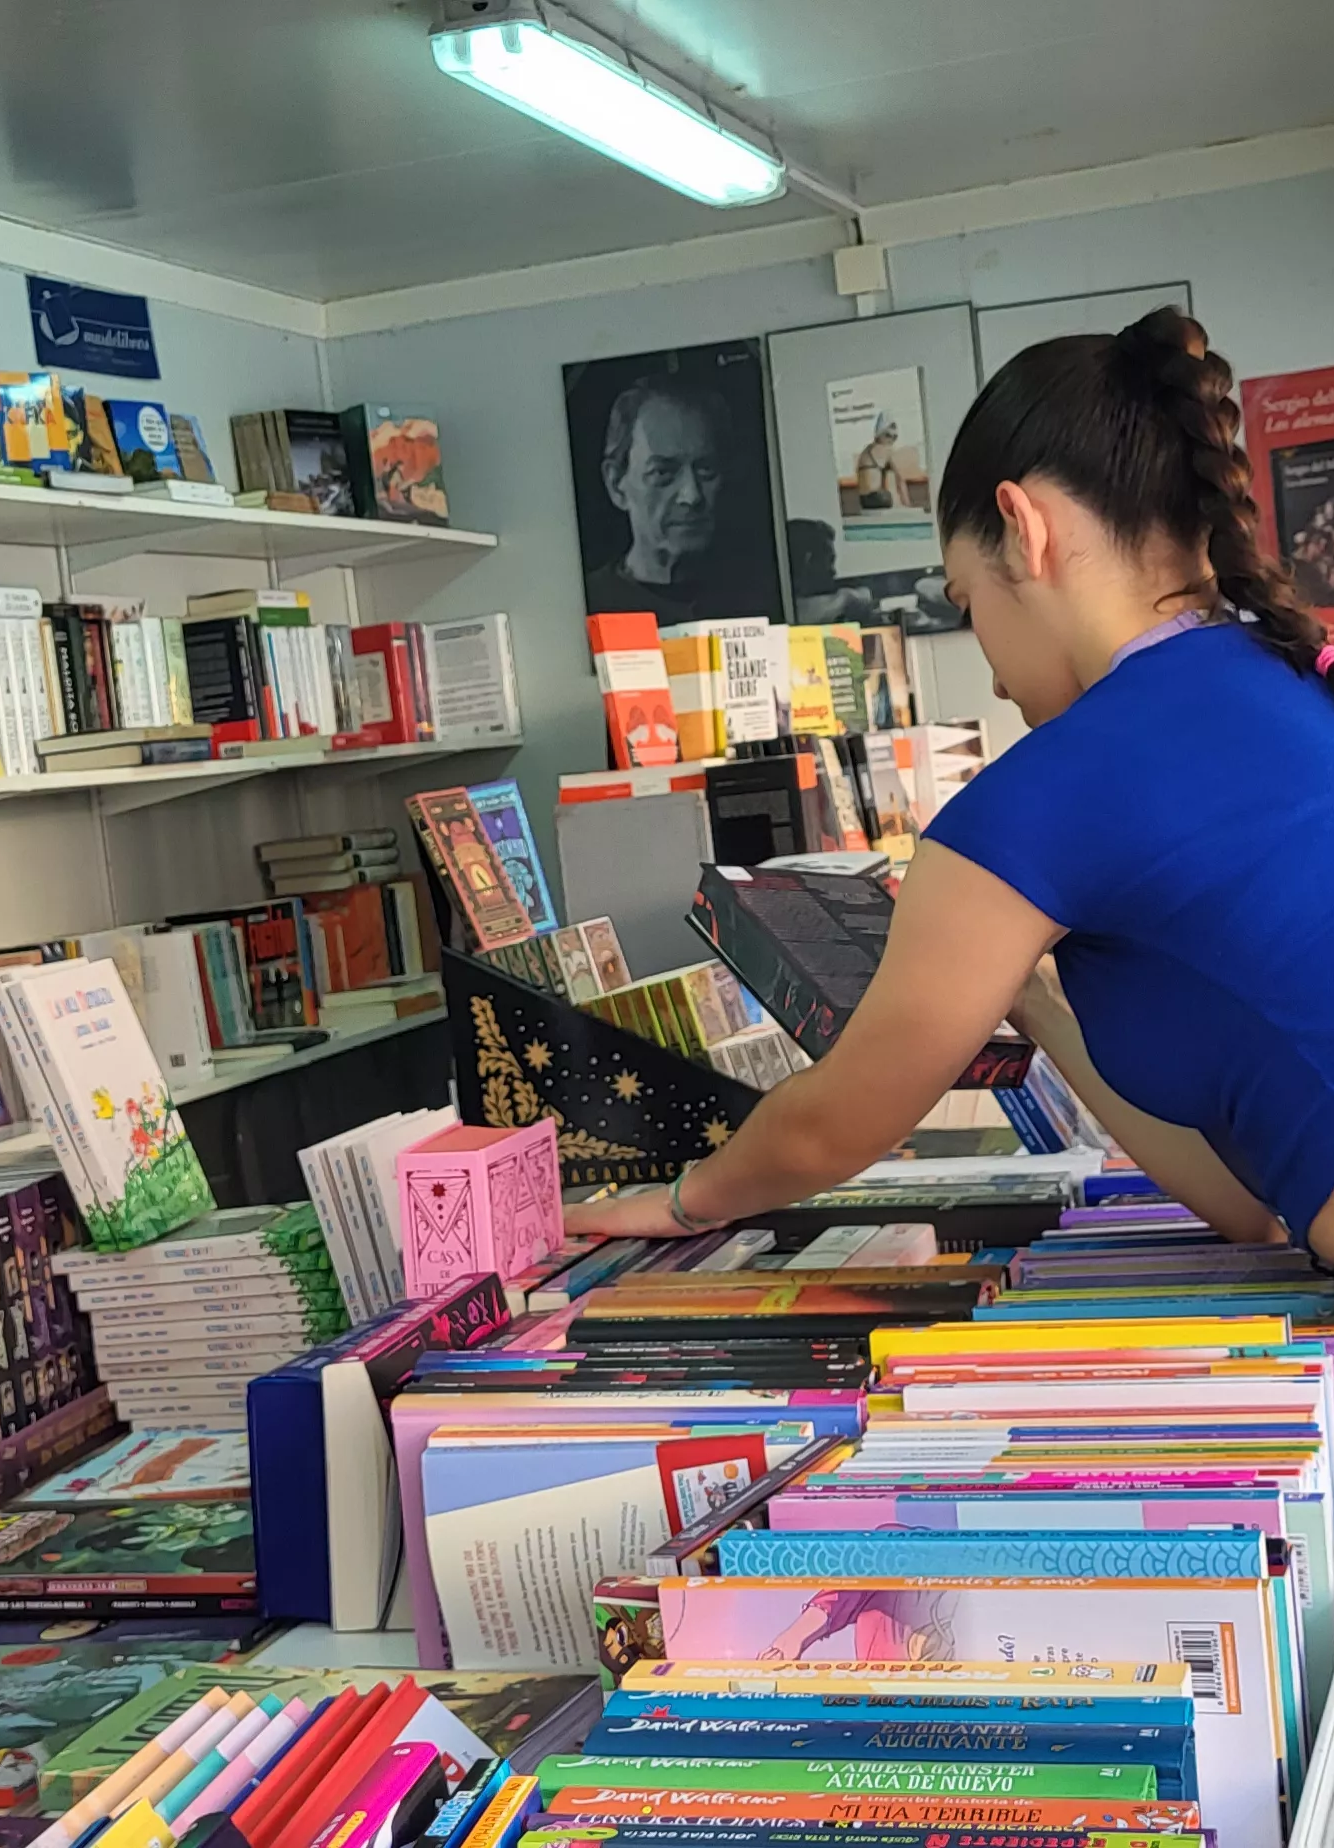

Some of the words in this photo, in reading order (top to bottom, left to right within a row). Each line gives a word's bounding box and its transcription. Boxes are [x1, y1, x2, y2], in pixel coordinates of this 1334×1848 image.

[439, 1269, 452, 1280] DE
[607, 1717, 698, 1734] David
[699, 1718, 809, 1734] Walliams
[863, 1734, 1029, 1751] ALUCINANTE
[556, 1755, 644, 1769] David
[648, 1756, 761, 1769] Walliams
[825, 1774, 900, 1790] ATACA
[906, 1775, 936, 1791] DE
[938, 1775, 1013, 1792] NUEVO
[828, 1803, 862, 1819] MI
[868, 1803, 908, 1820] TÍA
[917, 1805, 1042, 1823] TERRIBLE
